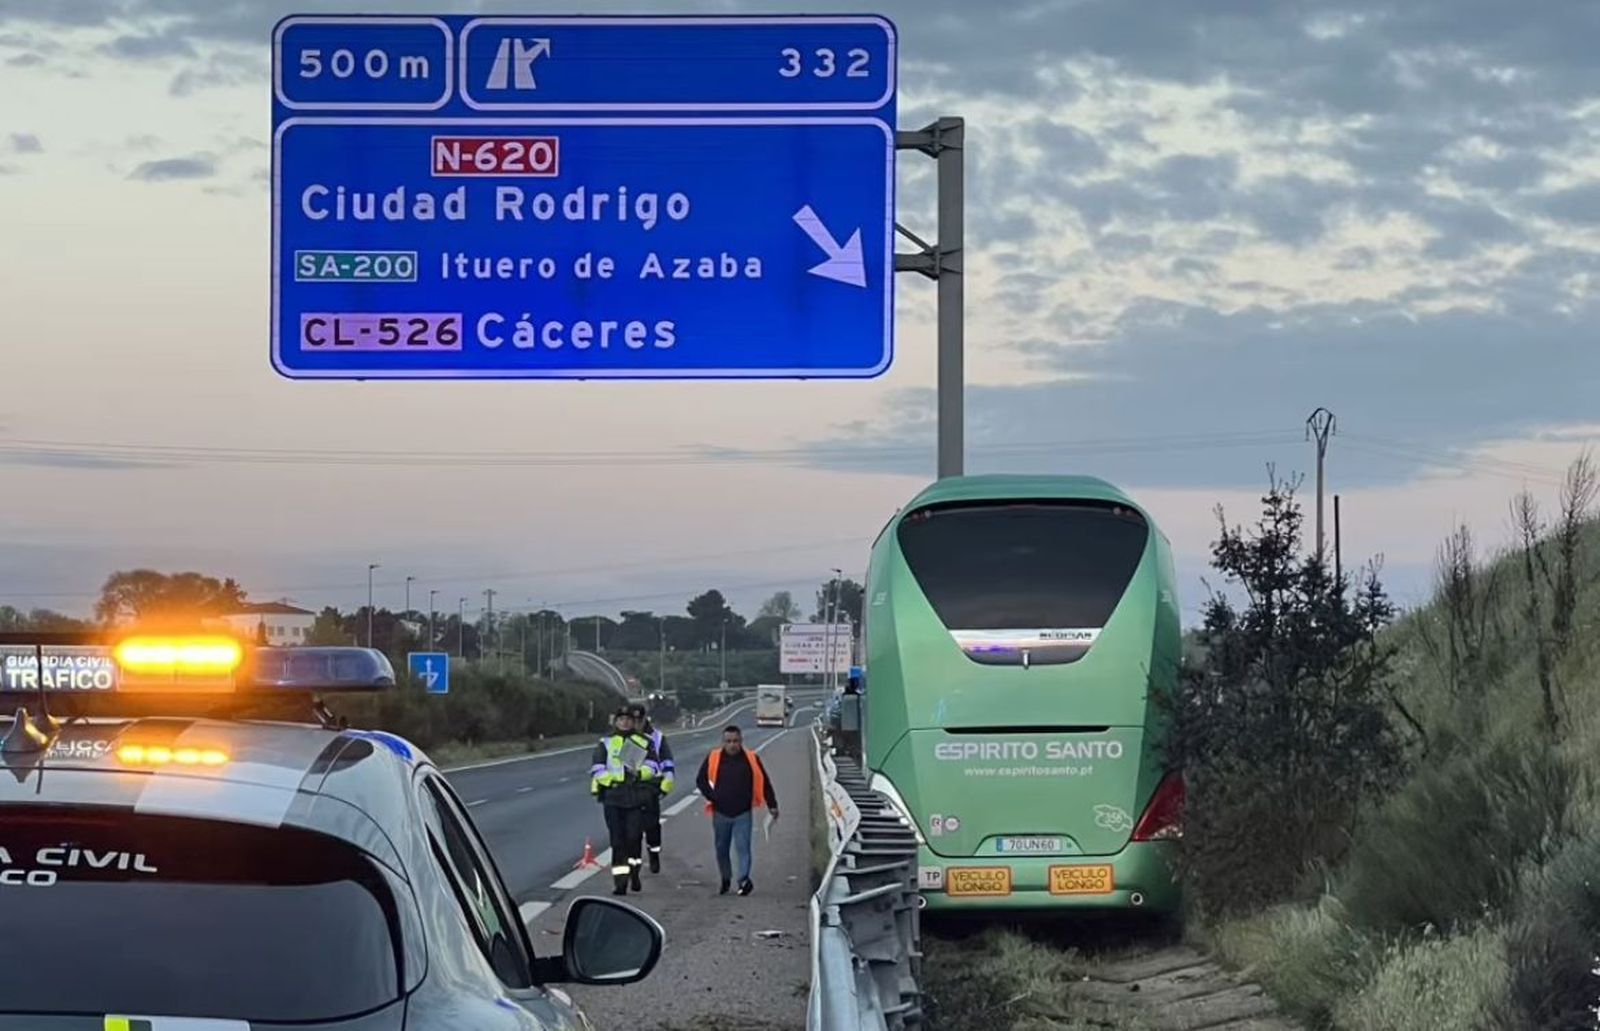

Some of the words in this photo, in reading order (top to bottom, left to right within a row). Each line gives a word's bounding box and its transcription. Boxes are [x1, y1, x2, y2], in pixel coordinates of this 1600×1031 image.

[778, 48, 870, 78] 332
[436, 142, 553, 171] N-620
[301, 185, 466, 221] Ciudad
[495, 185, 690, 230] Rodrigo
[300, 255, 413, 278] SA-200
[442, 253, 556, 279] Ituero
[574, 253, 615, 279] de
[640, 253, 762, 279] Azaba
[304, 317, 459, 346] CL-526
[477, 313, 676, 349] Cáceres
[6, 655, 74, 668] GUARDIA
[76, 656, 113, 668] CIVIL
[6, 669, 113, 690] TRAFICO
[934, 742, 1039, 760] ESPIRITO
[1045, 740, 1123, 759] SANTO
[964, 766, 1094, 777] www.espiritosanto.pt
[36, 848, 157, 873] CIVIL
[926, 872, 940, 881] TP
[956, 881, 1003, 891] LONGO
[1058, 880, 1105, 890] LONGO
